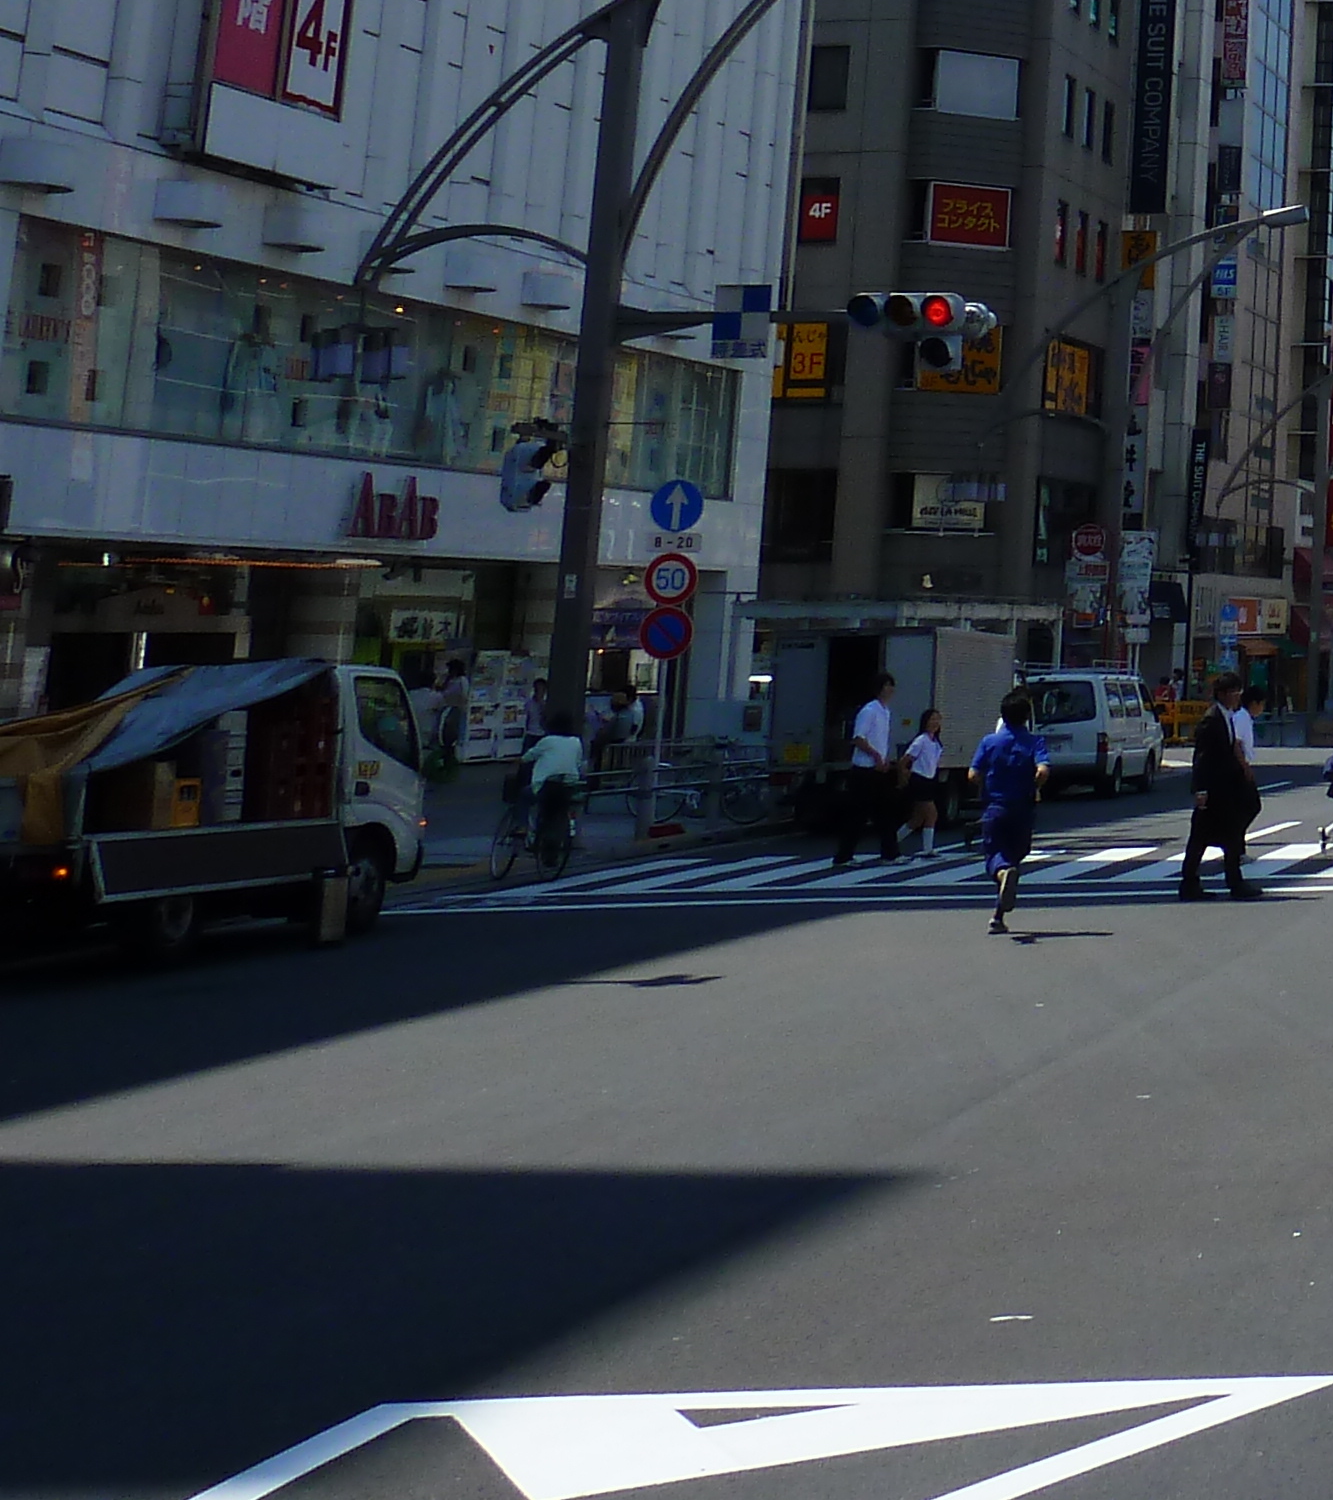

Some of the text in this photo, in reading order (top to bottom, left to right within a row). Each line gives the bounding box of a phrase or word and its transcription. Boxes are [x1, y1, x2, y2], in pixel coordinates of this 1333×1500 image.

[1148, 24, 1167, 70] SUIT
[1138, 76, 1166, 184] COMPANY
[808, 204, 831, 218] 4F
[791, 353, 824, 375] 3F
[1195, 442, 1205, 460] THE
[1192, 464, 1203, 488] SUIT
[346, 471, 440, 540] ABAB
[656, 568, 686, 590] 50
